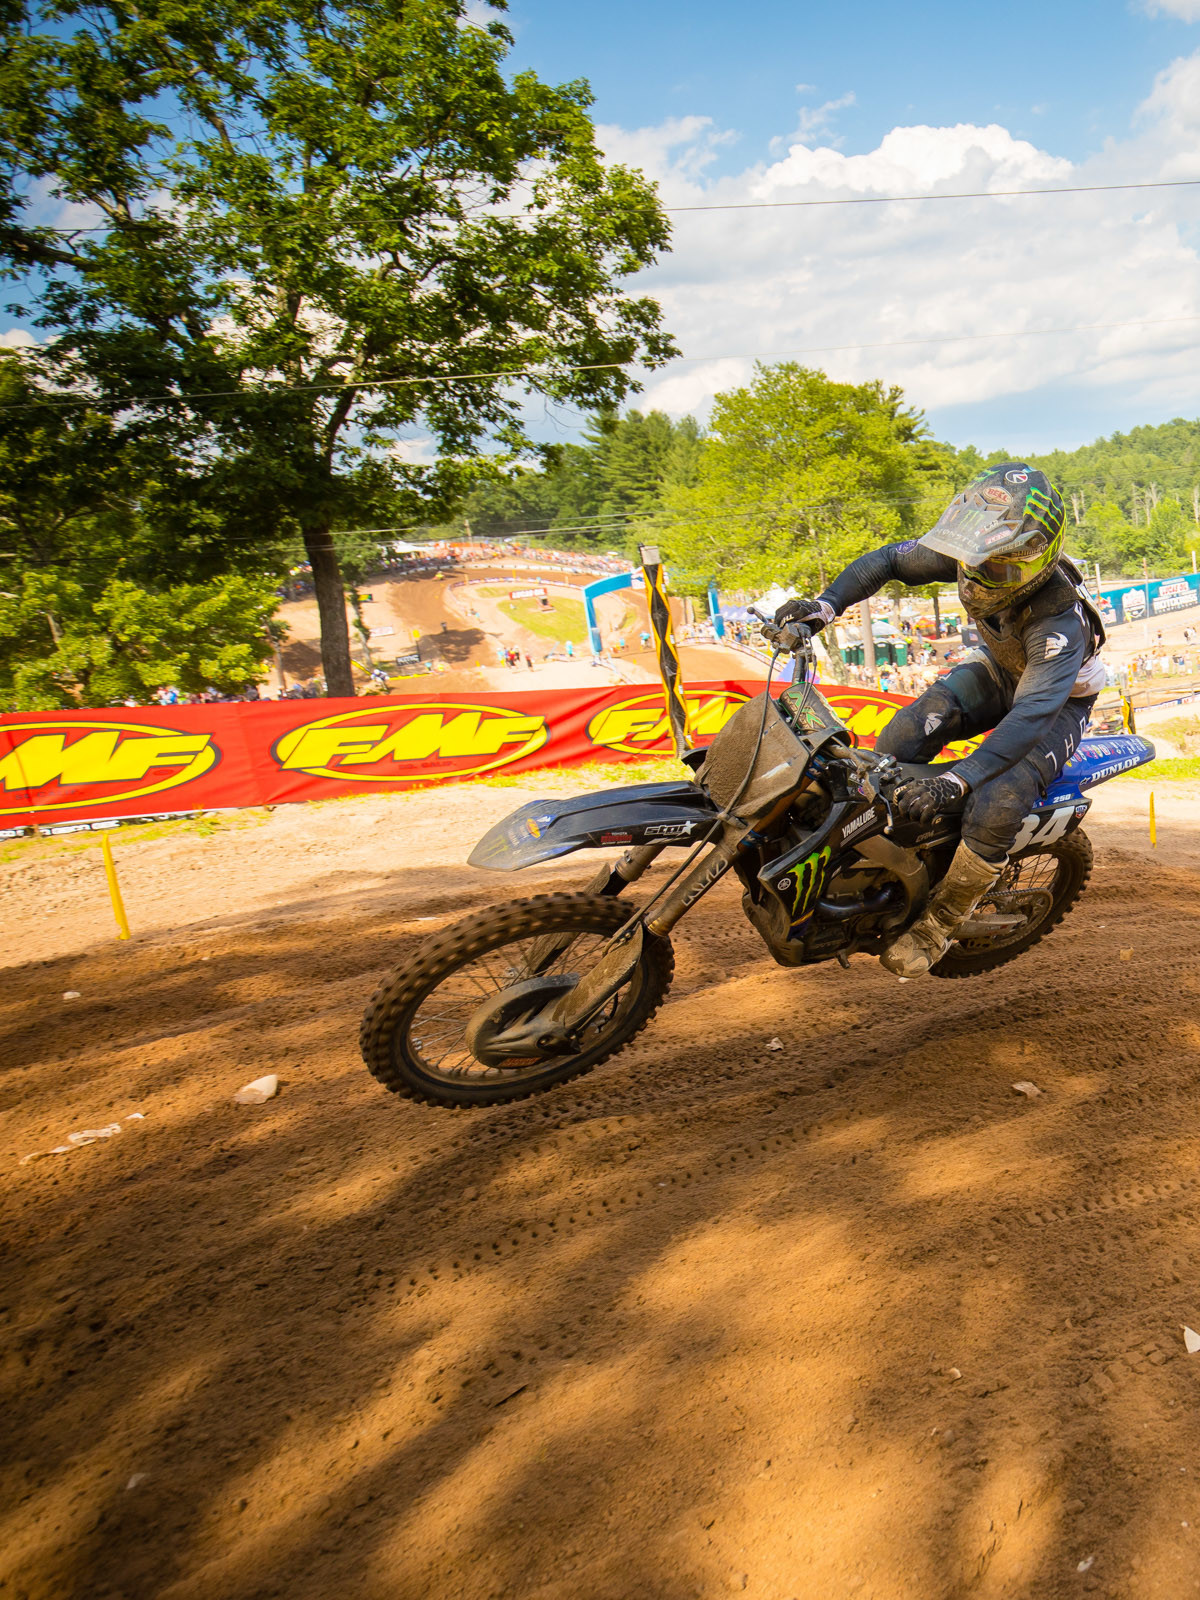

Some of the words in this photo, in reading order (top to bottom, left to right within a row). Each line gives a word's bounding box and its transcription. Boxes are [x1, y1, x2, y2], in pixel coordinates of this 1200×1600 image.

[0, 731, 212, 791] MF
[281, 711, 546, 770] FMF
[1090, 755, 1141, 783] DUNLOP
[841, 806, 876, 839] YAMALUBE
